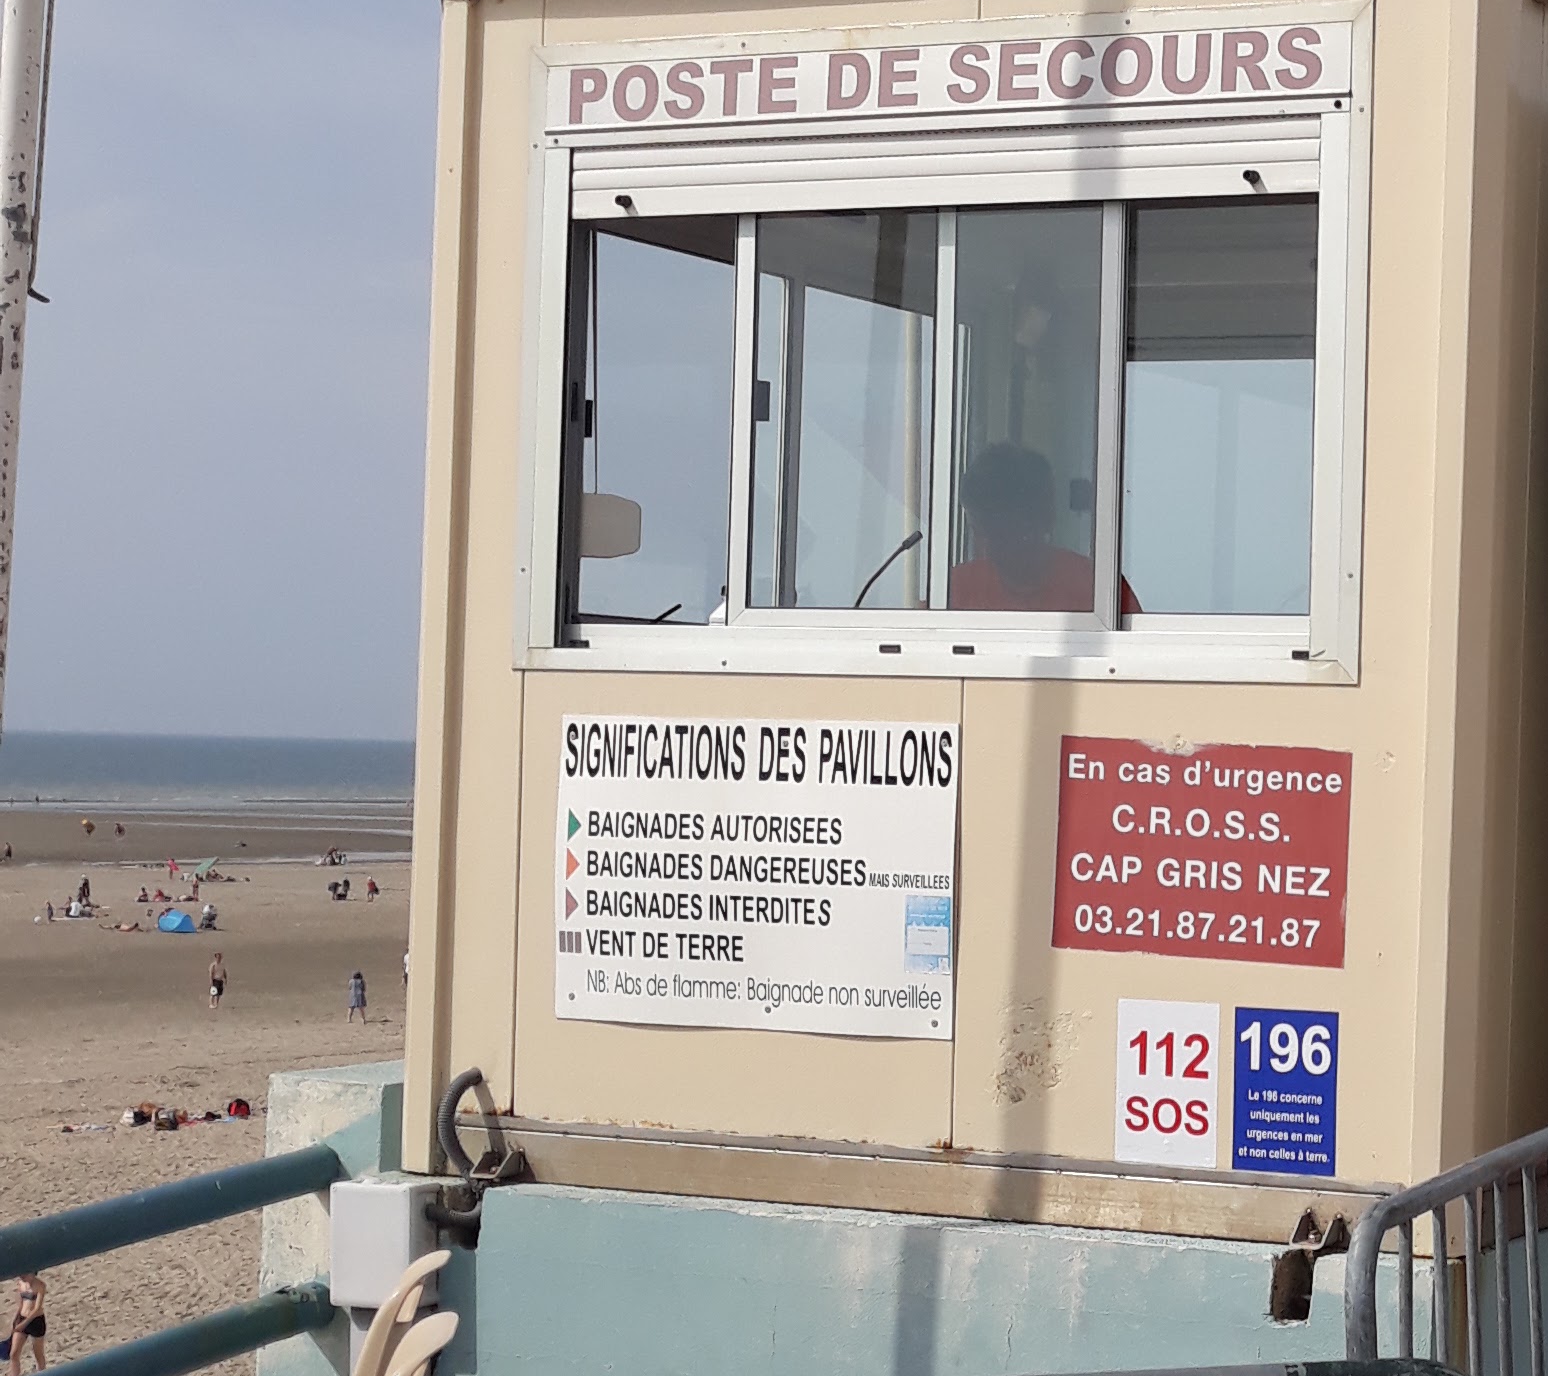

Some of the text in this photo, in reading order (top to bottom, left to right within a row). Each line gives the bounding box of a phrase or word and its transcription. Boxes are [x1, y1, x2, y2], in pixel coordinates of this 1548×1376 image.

[569, 26, 1323, 125] POSTE DE SECOURS
[565, 723, 953, 787] SIGNIFICATIONS DES PAVILLONS
[1068, 753, 1342, 795] En cas d'urgence
[587, 810, 843, 845] BAIGNADES AUTORISEES
[1112, 804, 1291, 843] C.R.O.S.S.
[587, 850, 950, 890] BAIGNADES DANGEREUSES MAIS SURVEILLEES
[1070, 852, 1332, 897] CAP GRIS NEZ
[586, 890, 832, 926] BAIGNADES INTERDITES
[1074, 904, 1321, 948] 03.21.87.21.87
[586, 929, 744, 962] VENT DE TERRE
[587, 970, 942, 1010] NB: Abs de flamme: Baignade non surveillée
[1128, 1030, 1210, 1079] 112
[1240, 1020, 1332, 1076] 196
[1125, 1096, 1210, 1136] SOS
[1248, 1088, 1259, 1100] Le
[1280, 1093, 1322, 1105] concerne
[1250, 1109, 1320, 1124] uniquement les
[1238, 1146, 1248, 1157] et
[1249, 1148, 1267, 1158] non
[1269, 1148, 1296, 1160] celles
[1246, 1129, 1323, 1143] urgences en mer
